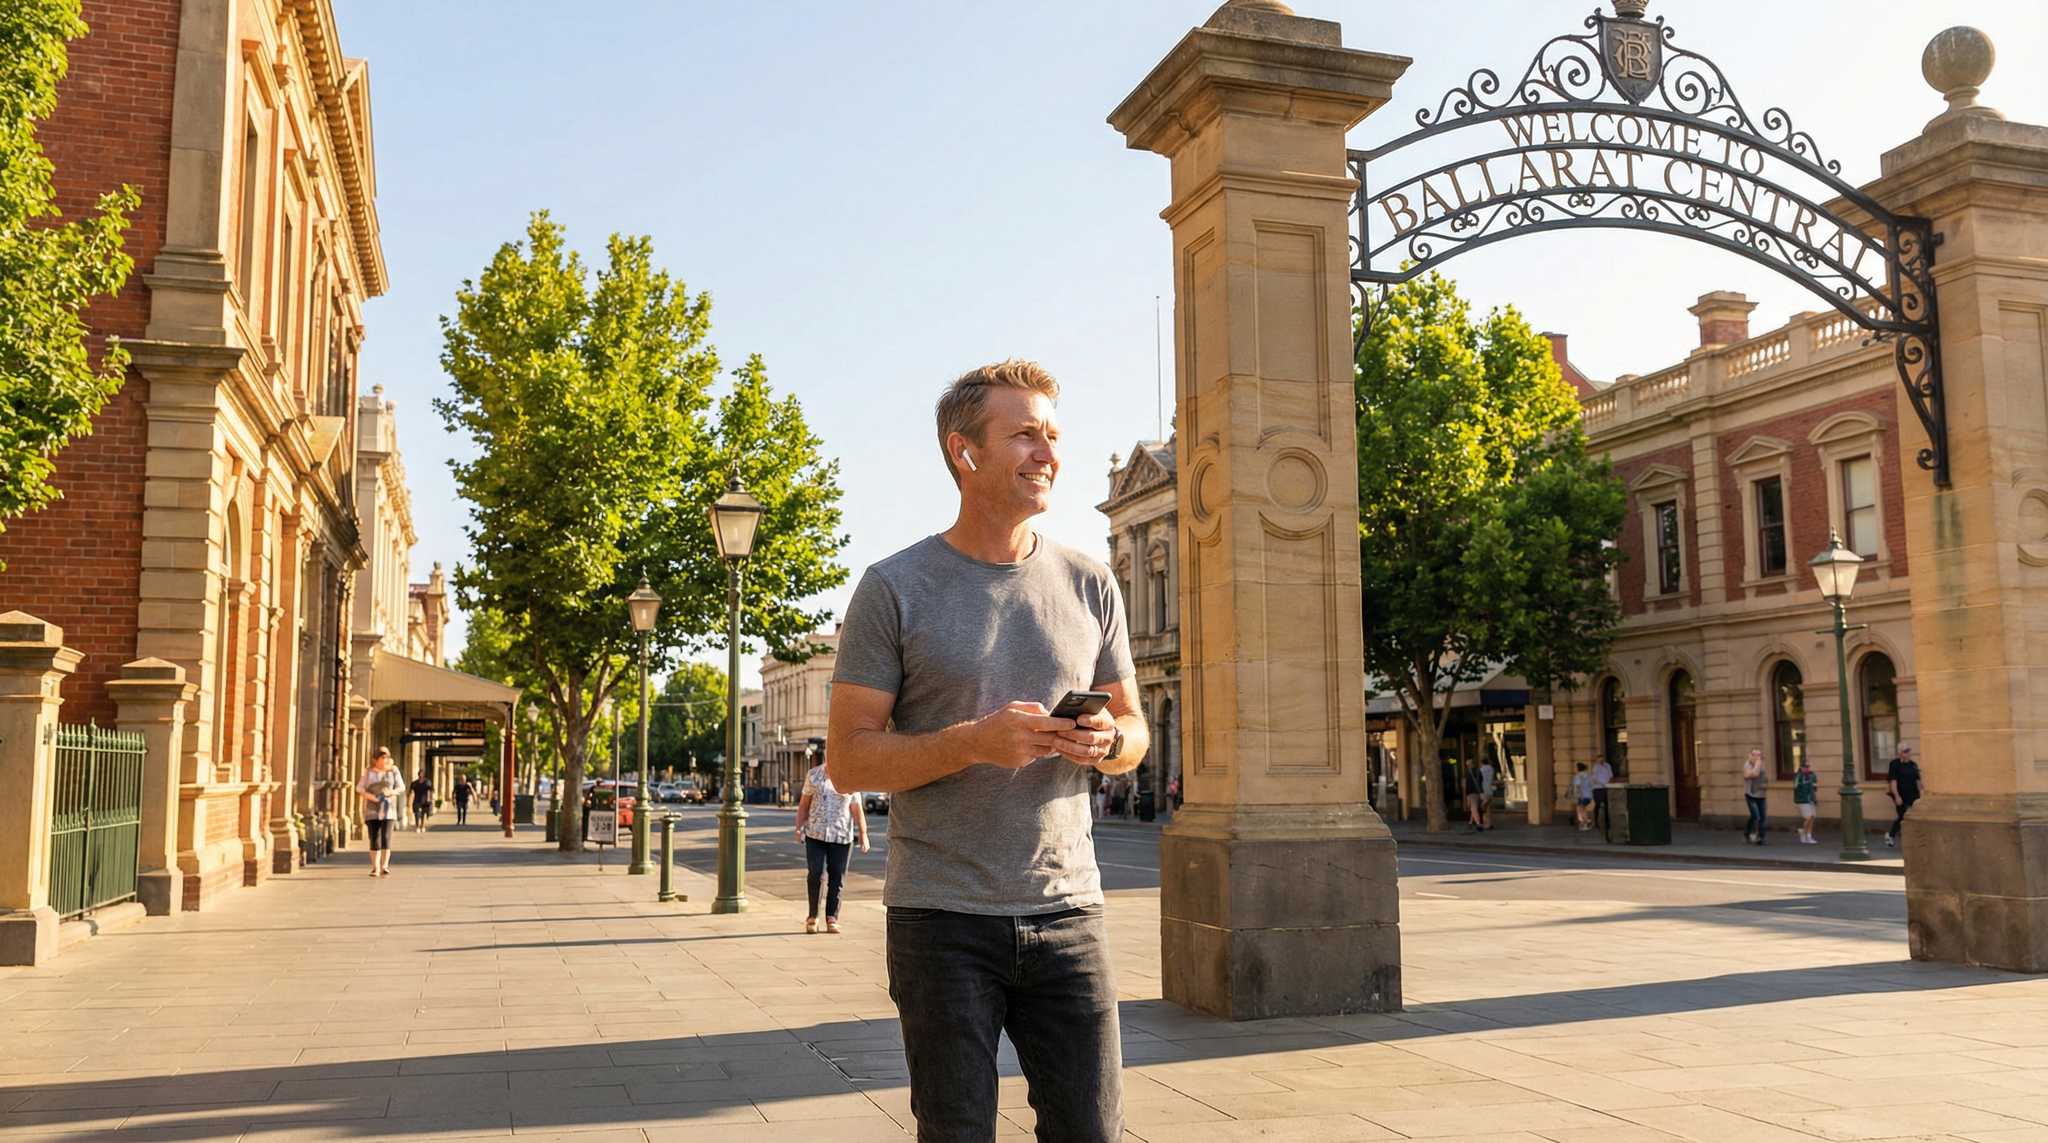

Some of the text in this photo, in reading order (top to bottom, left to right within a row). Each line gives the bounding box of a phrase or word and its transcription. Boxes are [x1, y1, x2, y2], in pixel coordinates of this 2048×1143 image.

[1501, 112, 1765, 176] WELCOME TO
[1378, 149, 1874, 283] BALLARAT CENTRAL
